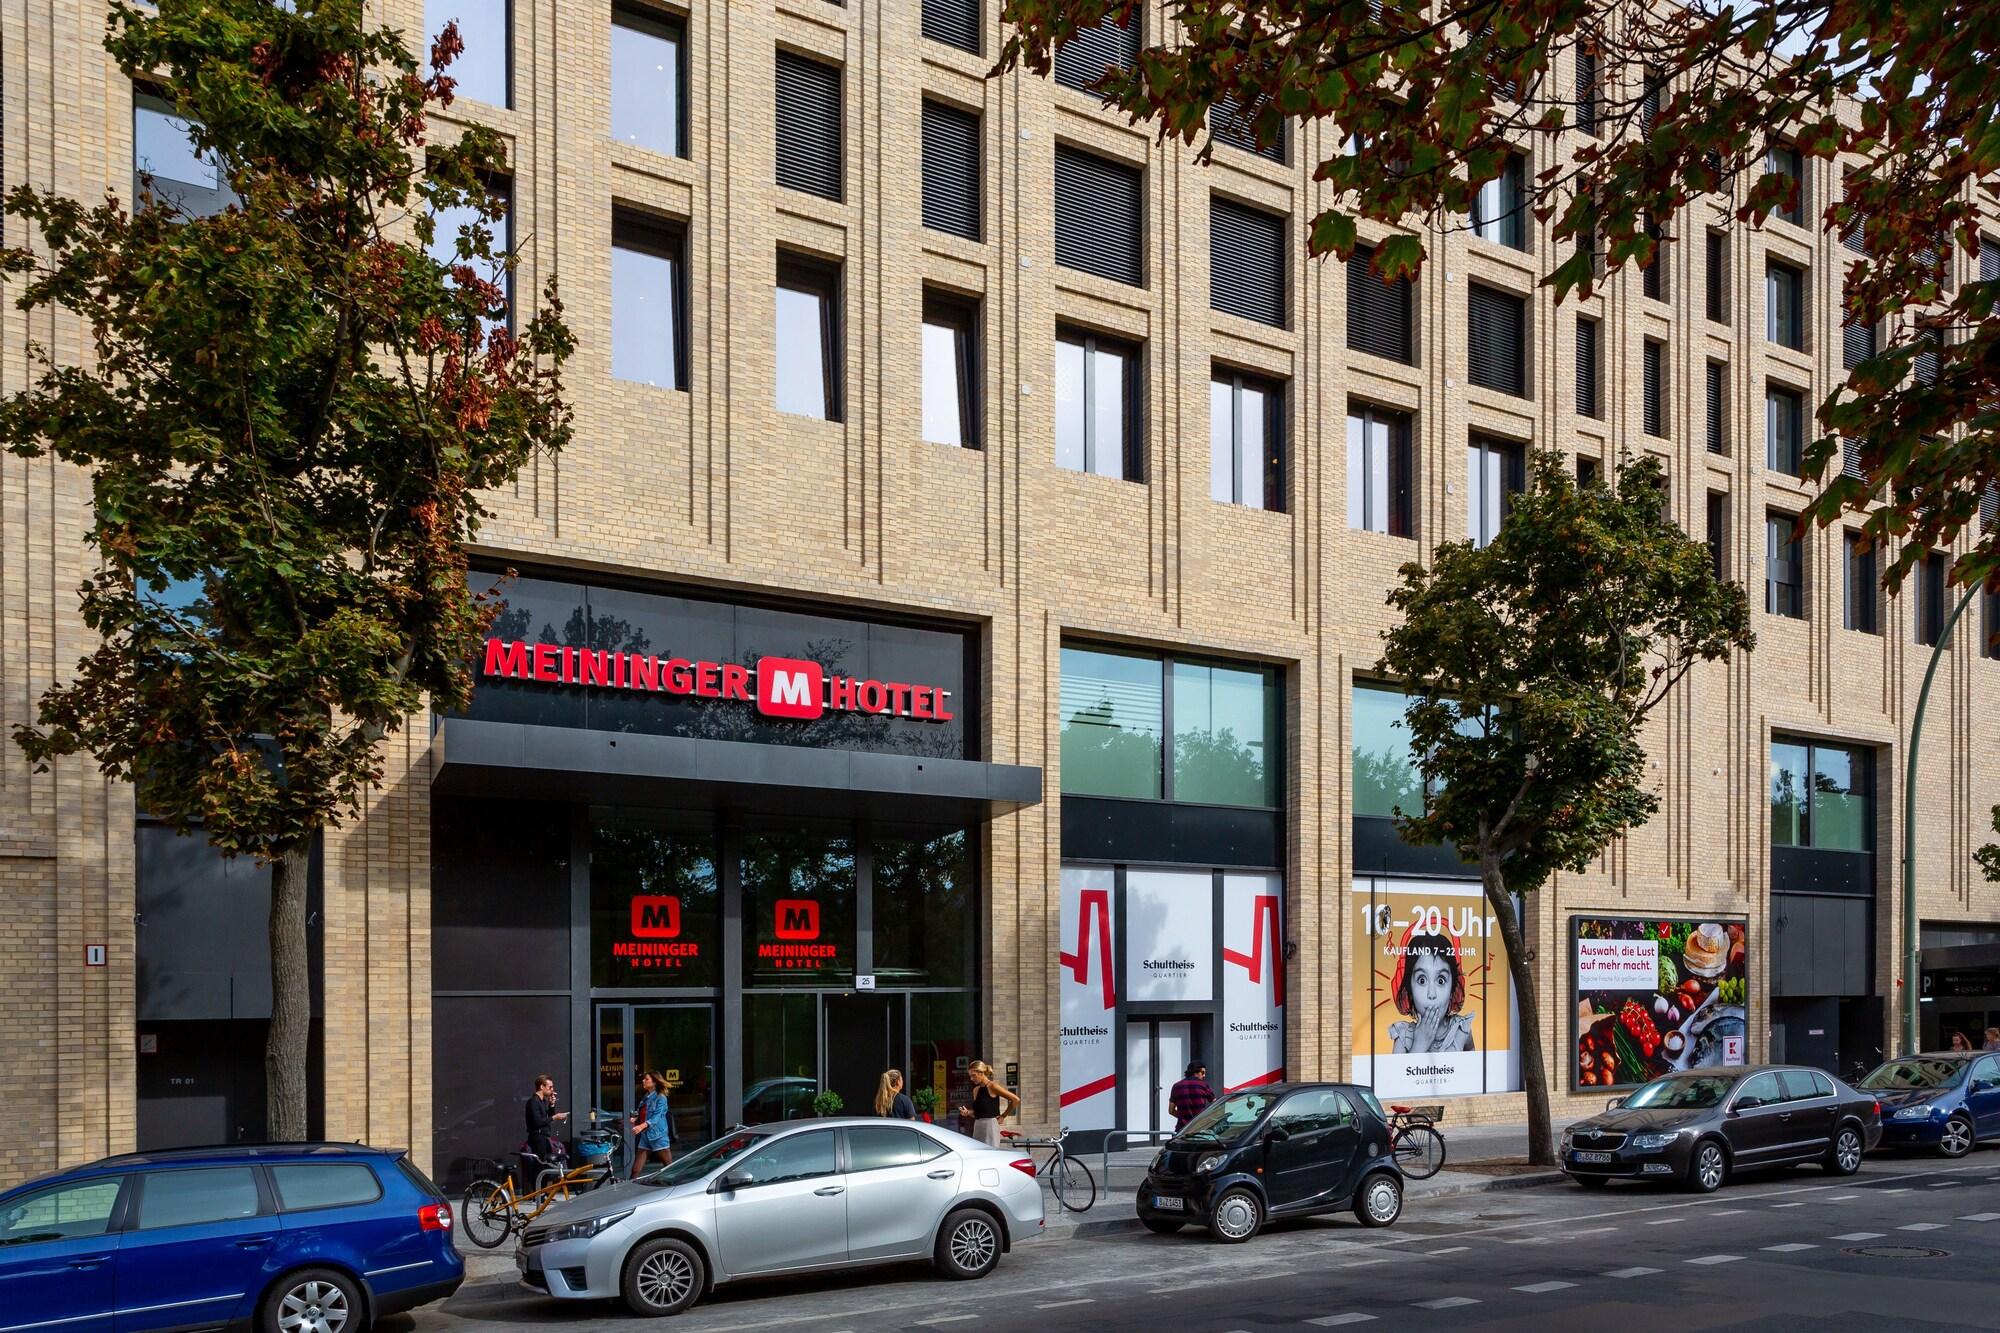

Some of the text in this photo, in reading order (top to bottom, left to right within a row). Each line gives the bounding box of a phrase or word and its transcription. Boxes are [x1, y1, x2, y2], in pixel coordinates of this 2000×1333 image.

[484, 637, 954, 720] MEININGER M HOTEL
[640, 904, 671, 929] M
[783, 907, 811, 930] M
[1447, 906, 1496, 937] Uhr
[612, 942, 699, 957] MEININGER
[758, 944, 836, 958] MEININGER
[1383, 946, 1431, 956] KAUFLAND
[1458, 947, 1476, 956] UHR
[1580, 944, 1655, 958] Auswahl, die Lust
[631, 957, 682, 968] HOTEL
[775, 958, 821, 968] HOTEL
[1143, 959, 1195, 969] Schultheiss
[1580, 959, 1652, 971] auf mehr macht.
[861, 977, 871, 985] 25
[1923, 975, 1932, 993] P
[1060, 1025, 1109, 1037] chultheiss
[1229, 1021, 1279, 1032] Schultheiss
[1405, 1064, 1455, 1076] Schultheiss
[170, 1077, 182, 1085] TR
